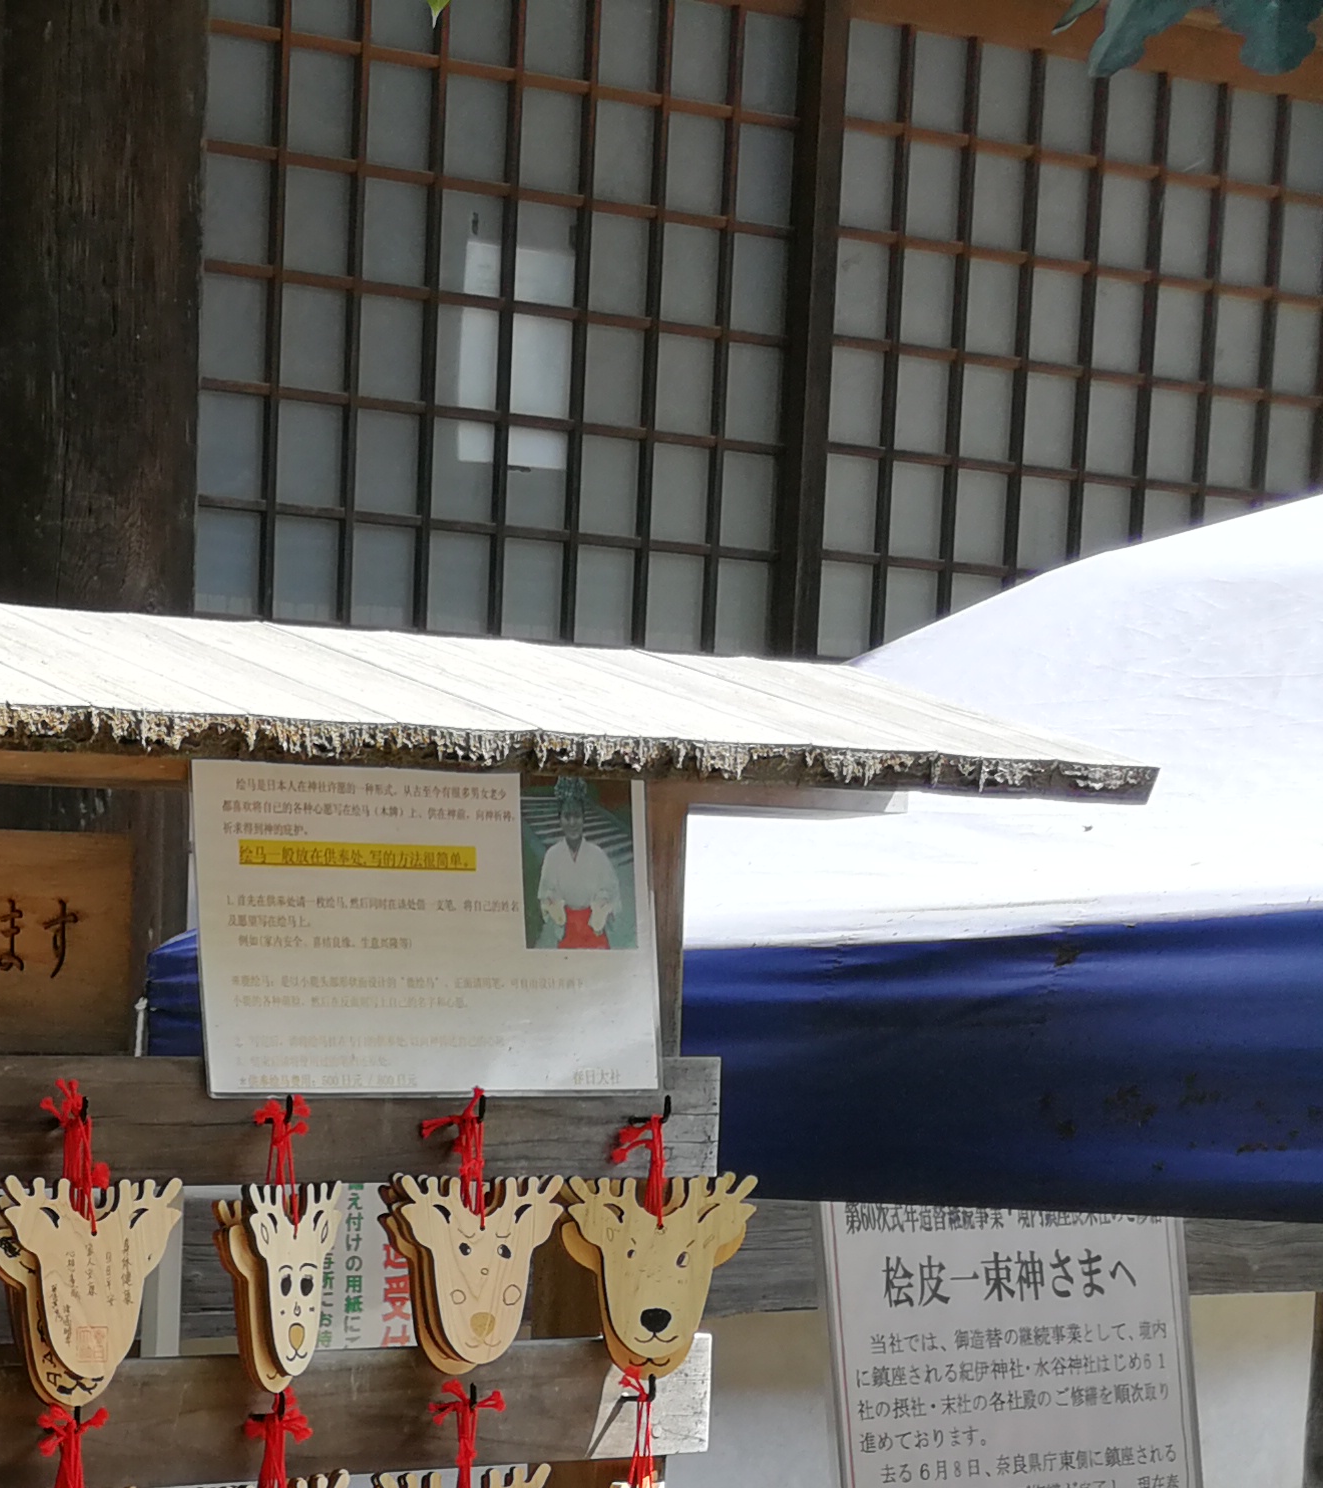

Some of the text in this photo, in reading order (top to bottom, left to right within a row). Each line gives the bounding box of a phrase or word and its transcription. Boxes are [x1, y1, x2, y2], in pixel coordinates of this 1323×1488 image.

[882, 1248, 1136, 1308] 桧皮一束神さまへ
[859, 1425, 986, 1454] 進めております。
